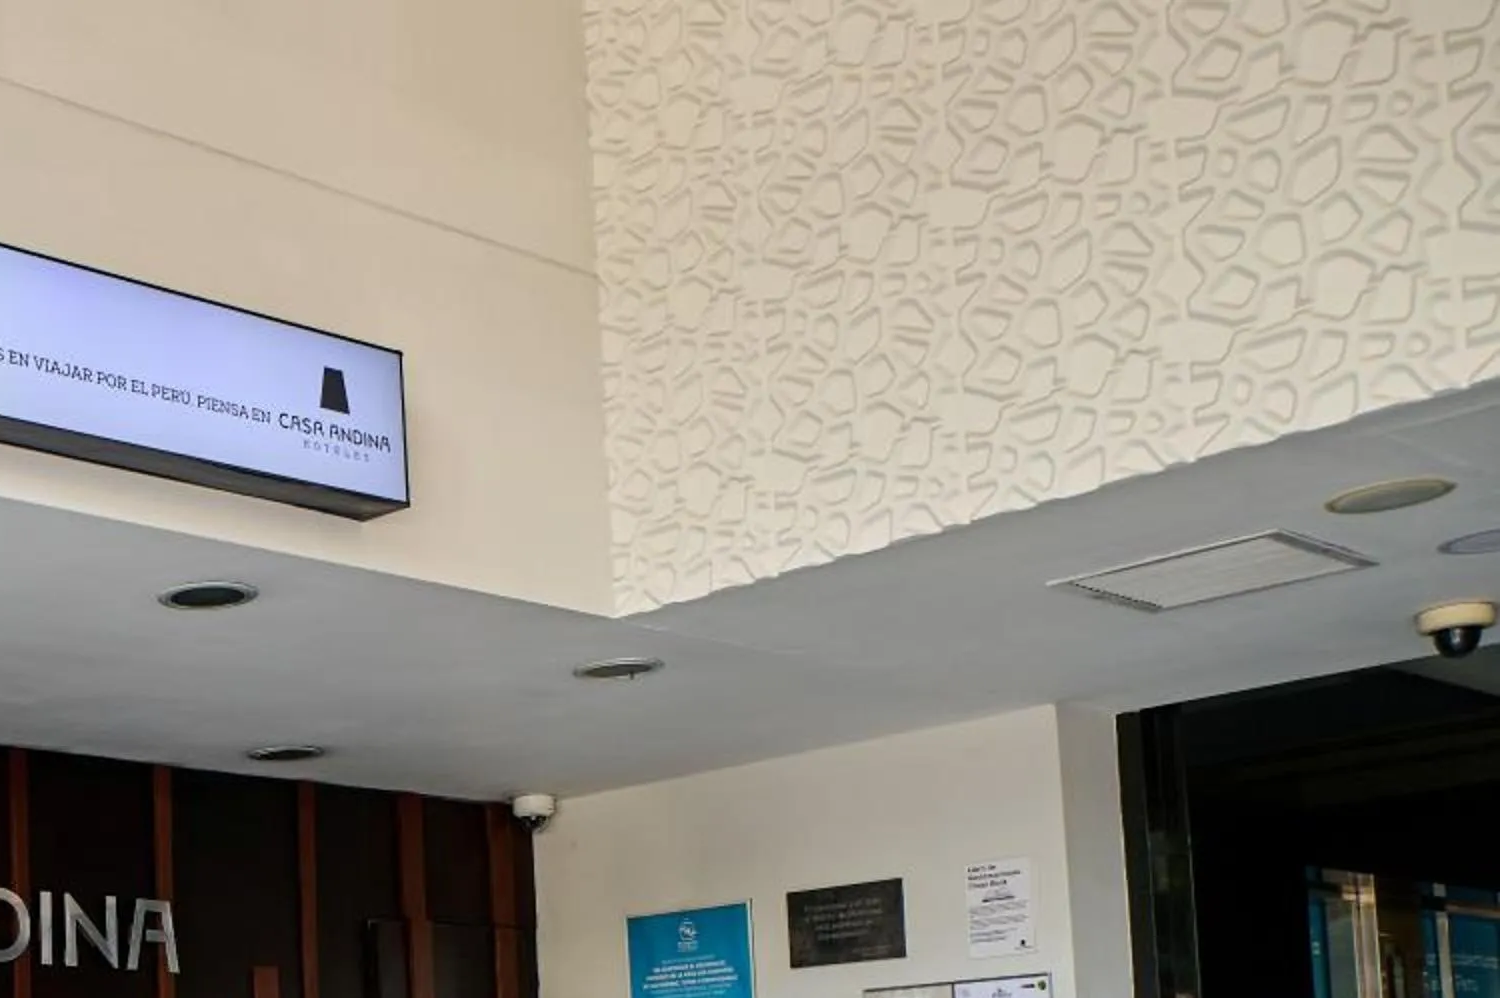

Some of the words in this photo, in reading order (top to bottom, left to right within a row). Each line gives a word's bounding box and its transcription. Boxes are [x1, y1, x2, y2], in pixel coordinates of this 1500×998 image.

[8, 349, 30, 368] EN
[33, 355, 93, 383] VIAJAR
[97, 371, 127, 391] POR
[131, 379, 149, 396] EL
[197, 394, 250, 419] PIENSA
[251, 407, 271, 424] EN
[278, 412, 325, 438] CASA
[329, 423, 391, 453] ANDINA
